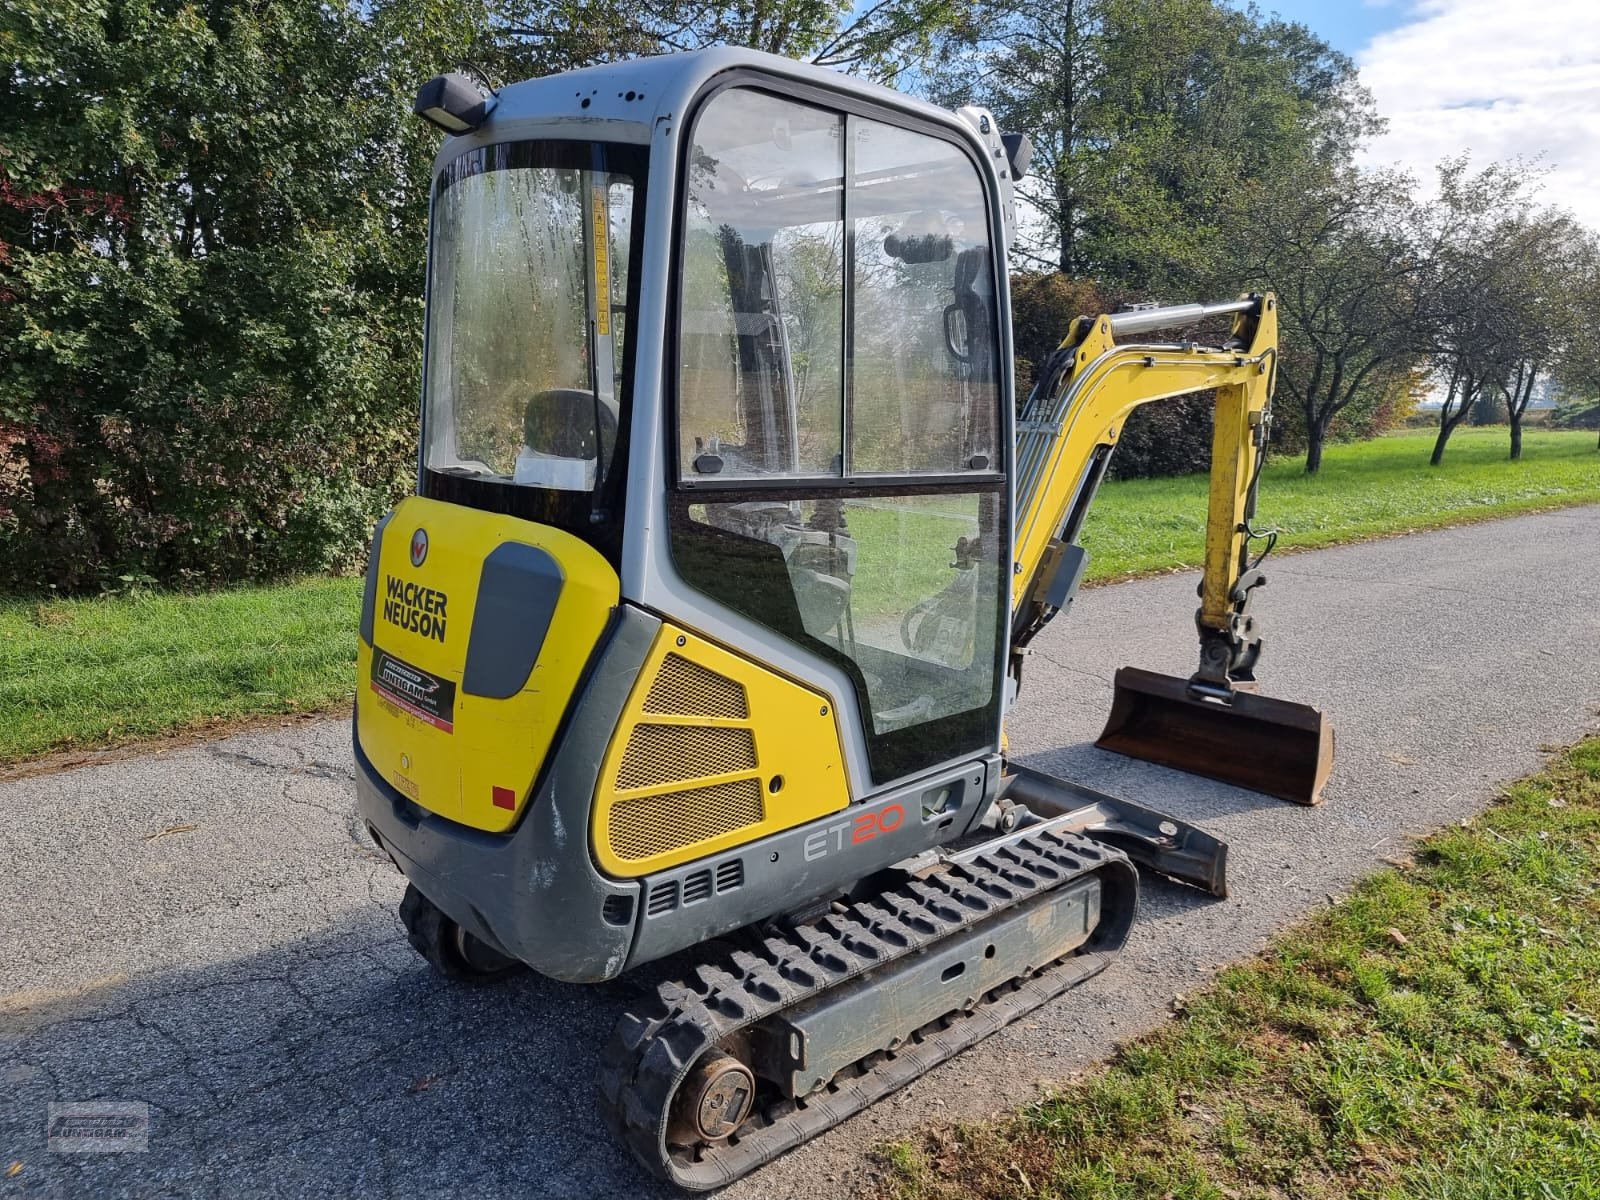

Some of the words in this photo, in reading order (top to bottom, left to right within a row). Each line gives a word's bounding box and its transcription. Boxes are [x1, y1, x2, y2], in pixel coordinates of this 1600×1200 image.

[386, 574, 448, 618] WACKER
[383, 598, 447, 643] NEUSON
[803, 803, 906, 862] ET20
